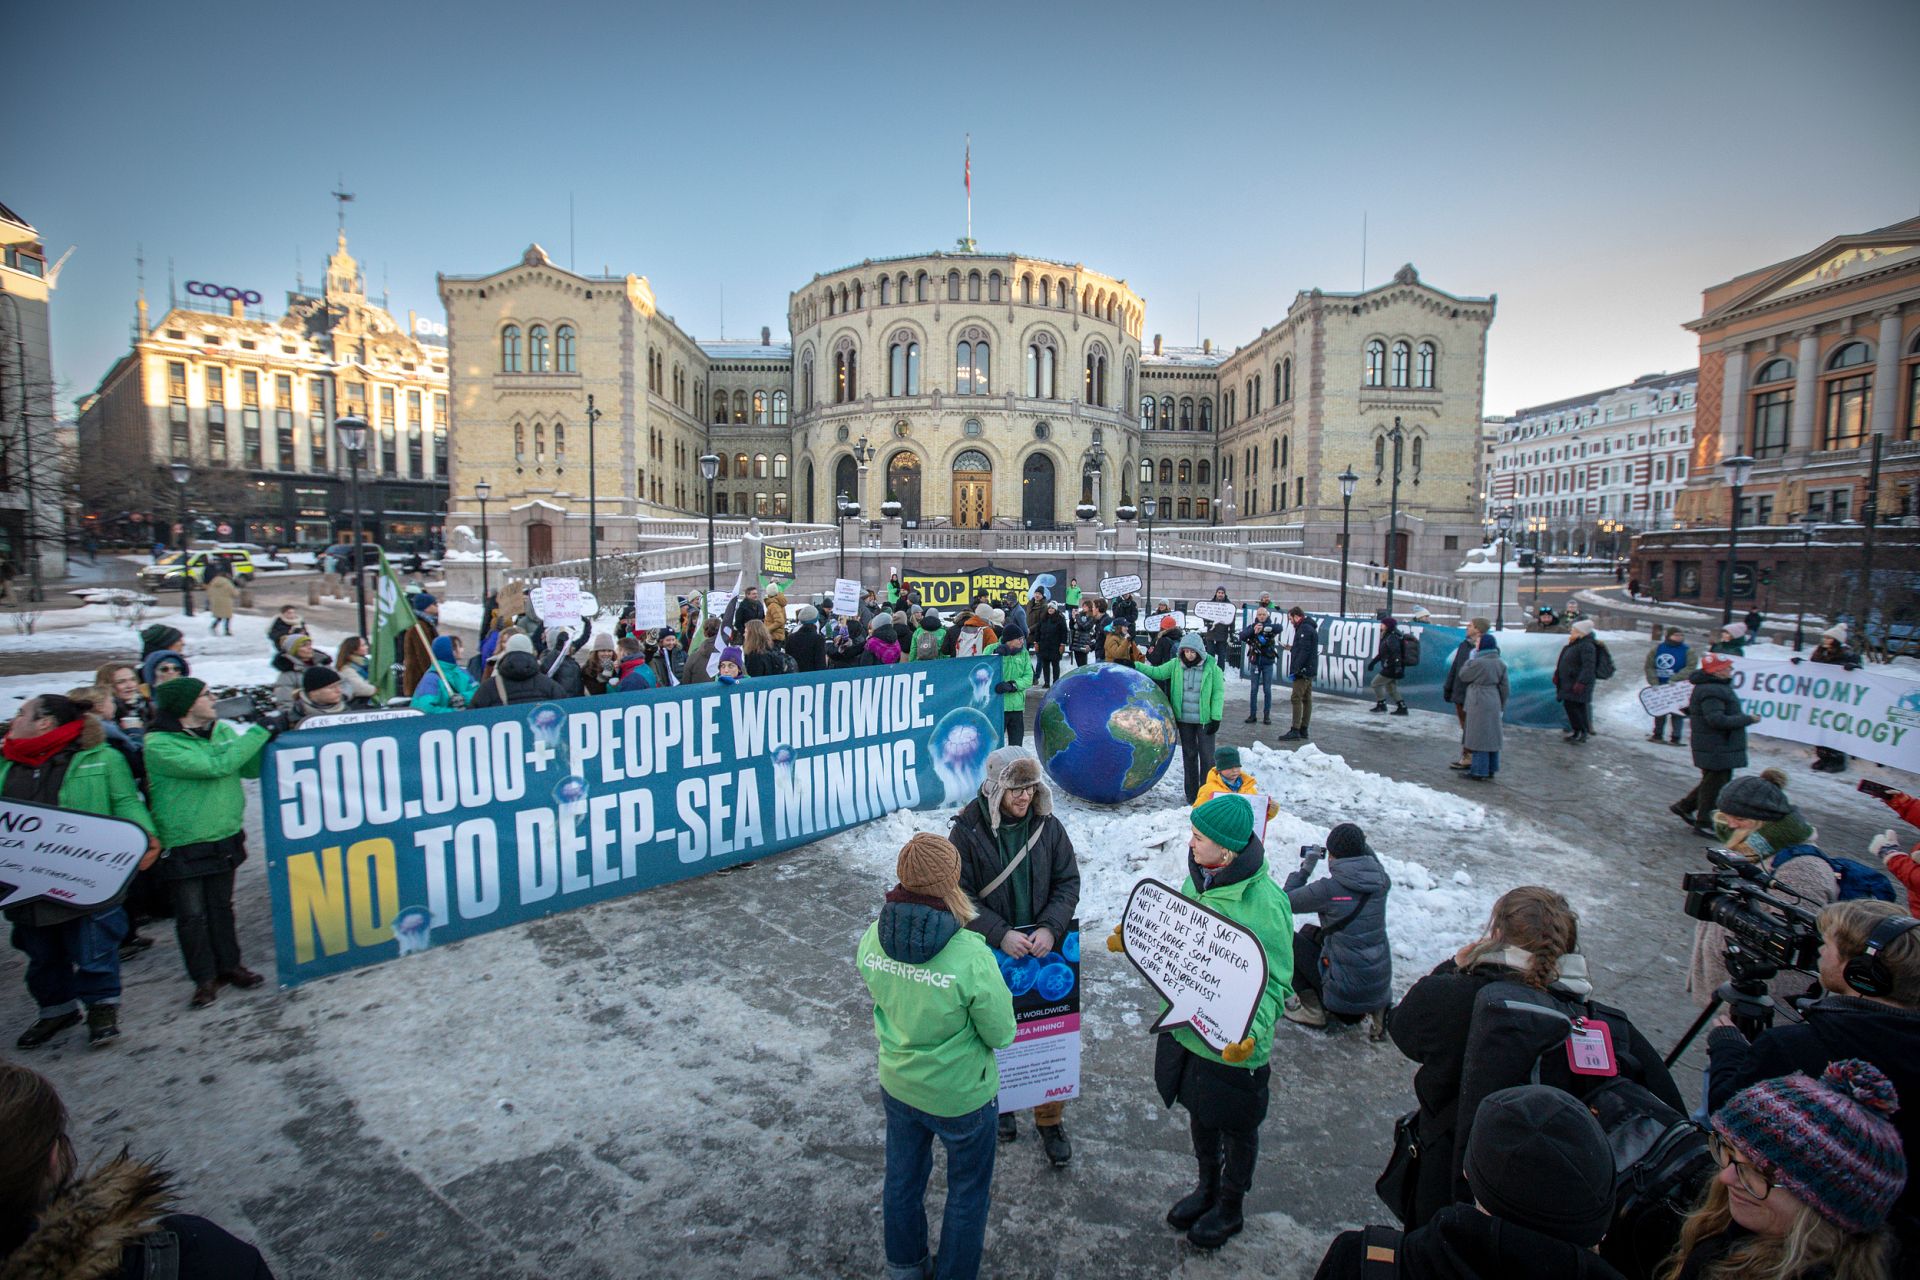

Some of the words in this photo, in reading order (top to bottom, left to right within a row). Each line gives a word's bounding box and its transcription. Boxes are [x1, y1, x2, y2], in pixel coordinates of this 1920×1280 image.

[186, 280, 263, 306] coop
[765, 558, 780, 567] DEEP
[766, 548, 791, 559] STOP
[764, 565, 793, 574] MINING
[545, 582, 575, 593] STOPP
[910, 580, 966, 603] STOP
[973, 575, 1005, 589] DEEP
[1006, 576, 1030, 590] SEA
[1752, 672, 1871, 706] ECONOMY
[1741, 699, 1803, 722] HOUT
[1809, 707, 1909, 746] ECOLOGY
[275, 719, 557, 841] 500.000+
[567, 694, 723, 783] PEOPLE
[731, 671, 935, 760] WORLDWIDE:
[0, 811, 42, 833] NO
[55, 822, 79, 834] TO
[286, 836, 401, 966] NO
[413, 816, 501, 931] TO
[515, 767, 765, 906] DEEP-SEA
[774, 738, 921, 842] MINING
[1139, 886, 1165, 903] ANDRE
[1166, 898, 1188, 916] LAND
[1190, 910, 1209, 931] HAR
[1213, 924, 1242, 944] SAGT
[1128, 909, 1144, 925] KAN
[1145, 918, 1160, 934] IKKE
[1160, 930, 1187, 951] NORGE
[1188, 949, 1212, 967] SOM
[1159, 910, 1171, 926] TIL
[1174, 920, 1192, 937] DET
[1193, 931, 1206, 947] SÅ
[1208, 940, 1249, 973] HVORFOR
[863, 952, 956, 989] GREENPEACE
[1153, 952, 1163, 965] OG
[1140, 956, 1162, 975] GJØRE
[1163, 973, 1185, 997] DET?
[1180, 957, 1199, 975] SEG
[1199, 970, 1221, 988] SOM
[1023, 1004, 1071, 1019] WORLDWIDE:
[1032, 1021, 1065, 1033] MINING!
[1045, 1084, 1074, 1098] AVAAZ
